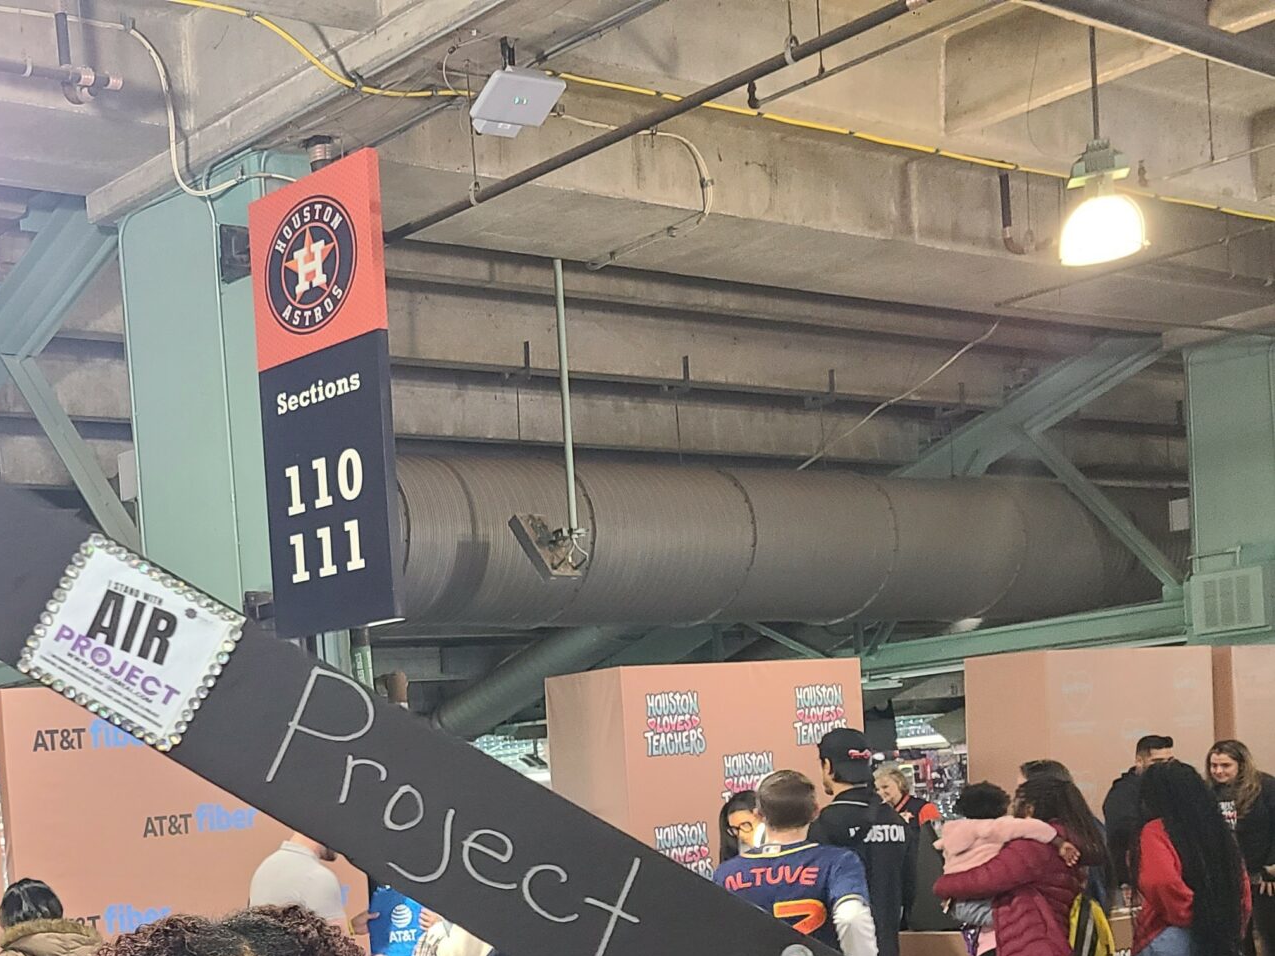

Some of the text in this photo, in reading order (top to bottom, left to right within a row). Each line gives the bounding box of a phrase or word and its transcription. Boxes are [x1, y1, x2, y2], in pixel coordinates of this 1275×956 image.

[275, 203, 343, 254] HOUSTON
[293, 239, 327, 294] H
[282, 284, 343, 326] ASTROS
[277, 372, 361, 416] Sections
[284, 448, 364, 516] 110
[289, 519, 366, 584] 111
[86, 589, 178, 665] AIR
[53, 624, 181, 706] PROJECT
[645, 690, 699, 717] HOUSTON
[794, 684, 843, 708] HOUSTON
[656, 714, 693, 733] LOVES
[804, 705, 837, 722] LOVES
[33, 728, 86, 752] AT&T
[644, 728, 706, 757] TEACHERS
[724, 752, 773, 778] HOUSTON
[143, 803, 258, 838] AT&T fiber
[655, 821, 708, 848] HOUSTON
[389, 928, 417, 943] AT&T
